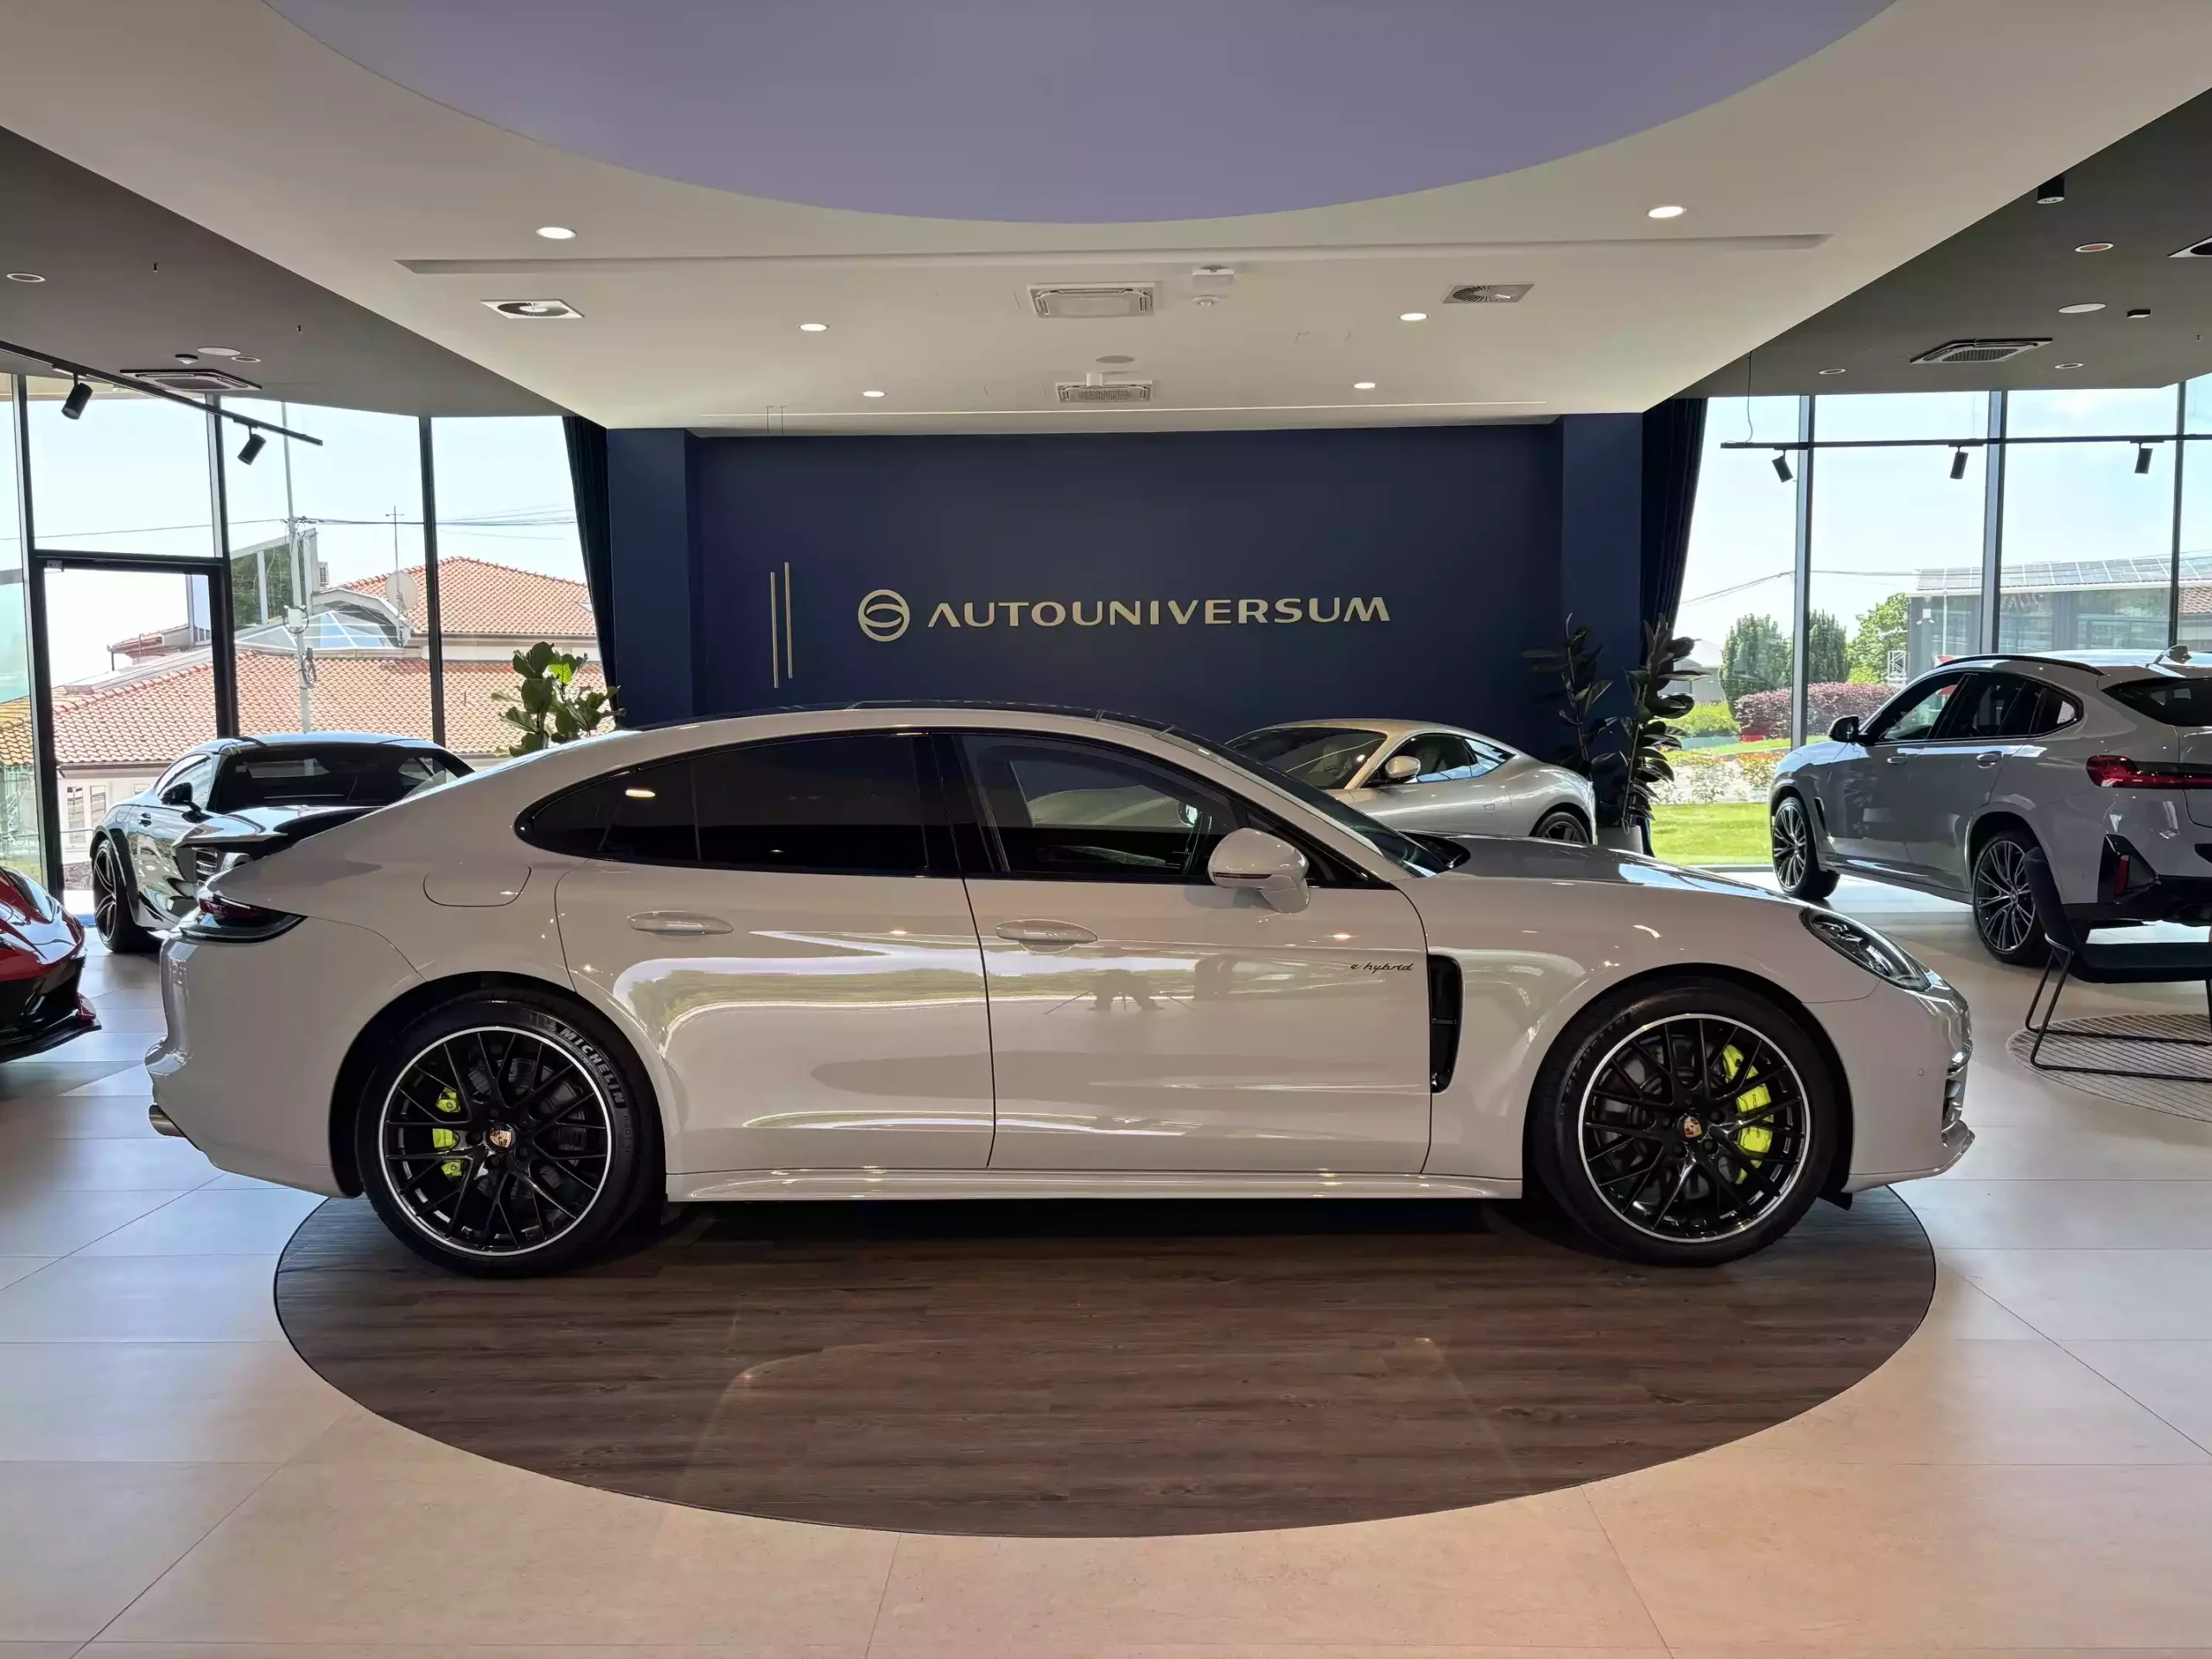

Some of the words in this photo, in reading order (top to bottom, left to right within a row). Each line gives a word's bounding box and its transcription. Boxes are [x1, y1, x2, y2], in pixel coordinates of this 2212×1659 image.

[927, 596, 1390, 628] AUTOUNIVERSUM
[559, 1027, 626, 1103] MICHELIN
[623, 1115, 632, 1141] PILOT
